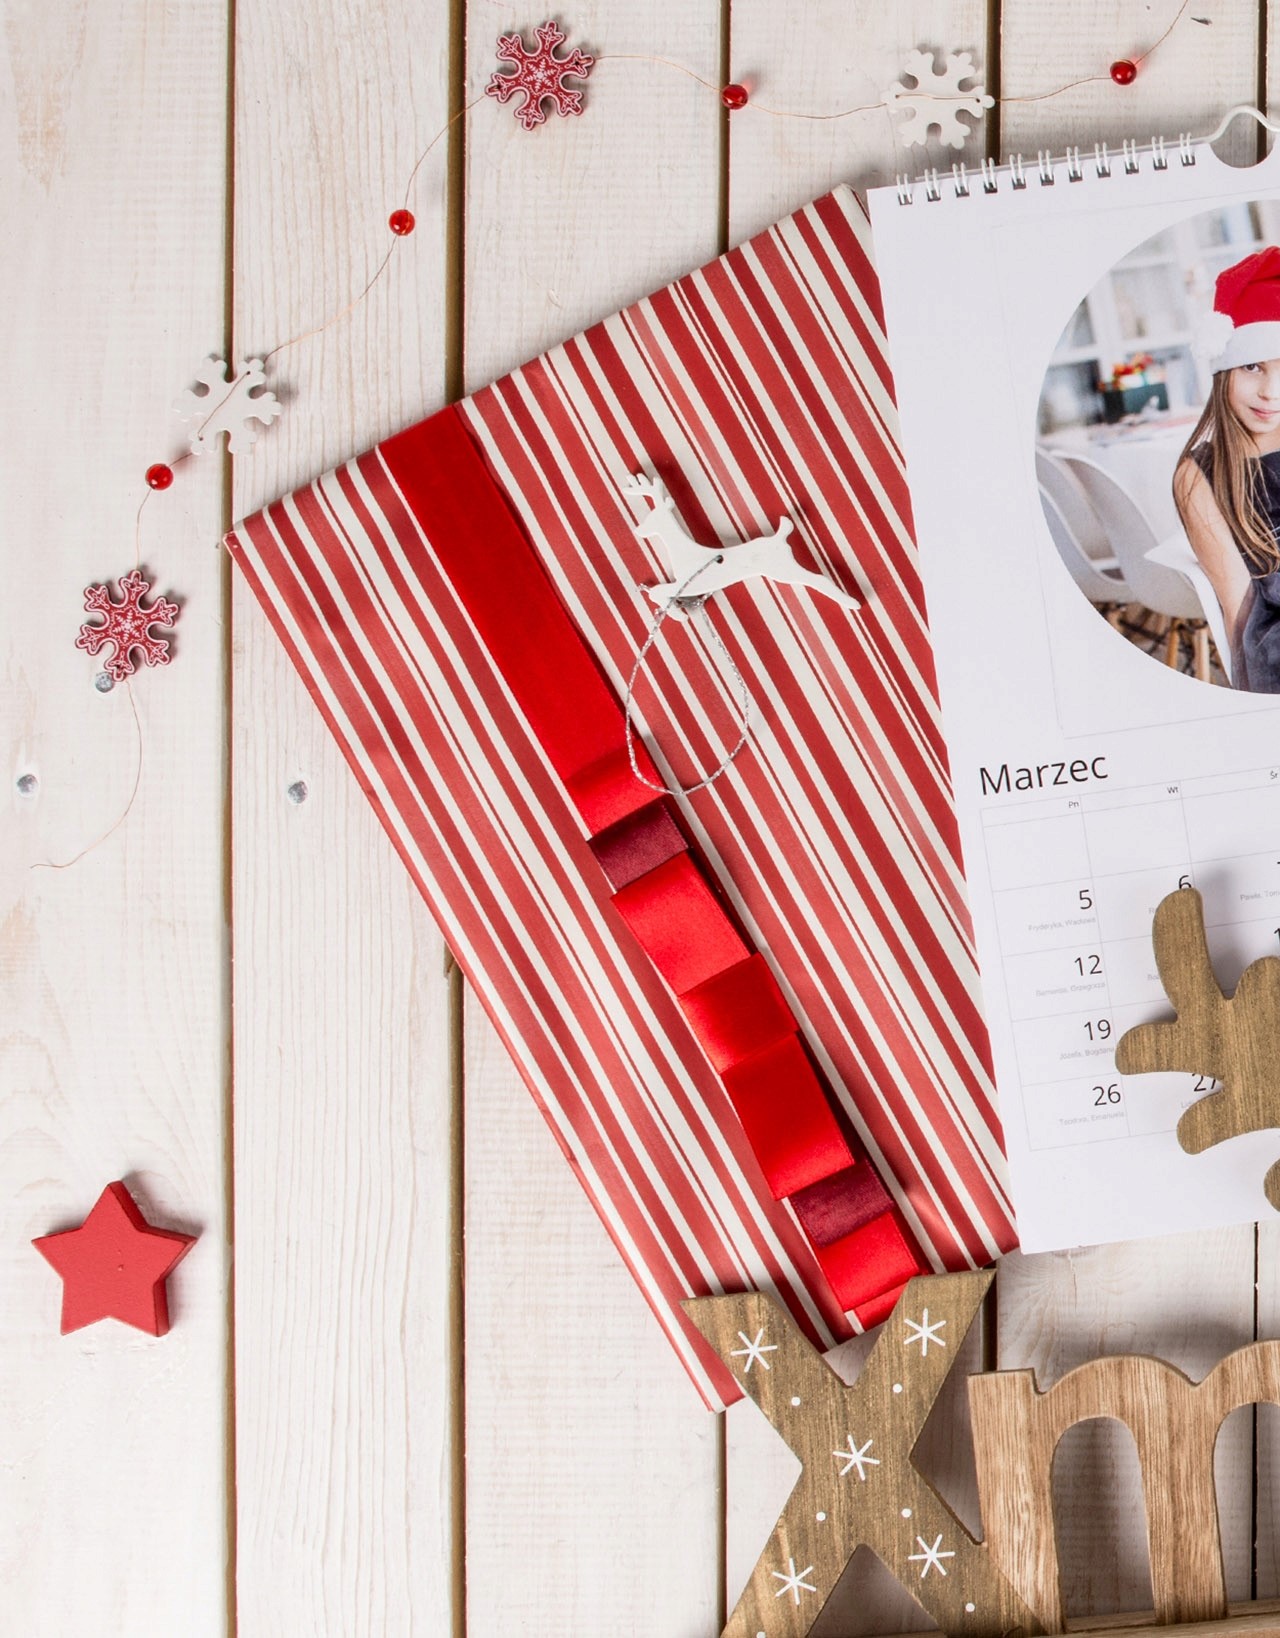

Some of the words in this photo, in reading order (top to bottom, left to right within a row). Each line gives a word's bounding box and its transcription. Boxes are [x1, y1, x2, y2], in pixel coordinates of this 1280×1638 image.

[979, 756, 1108, 795] Marzec
[1079, 889, 1092, 909] 5
[1074, 954, 1102, 976] 12
[1083, 1019, 1110, 1040] 19
[1092, 1083, 1120, 1106] 26
